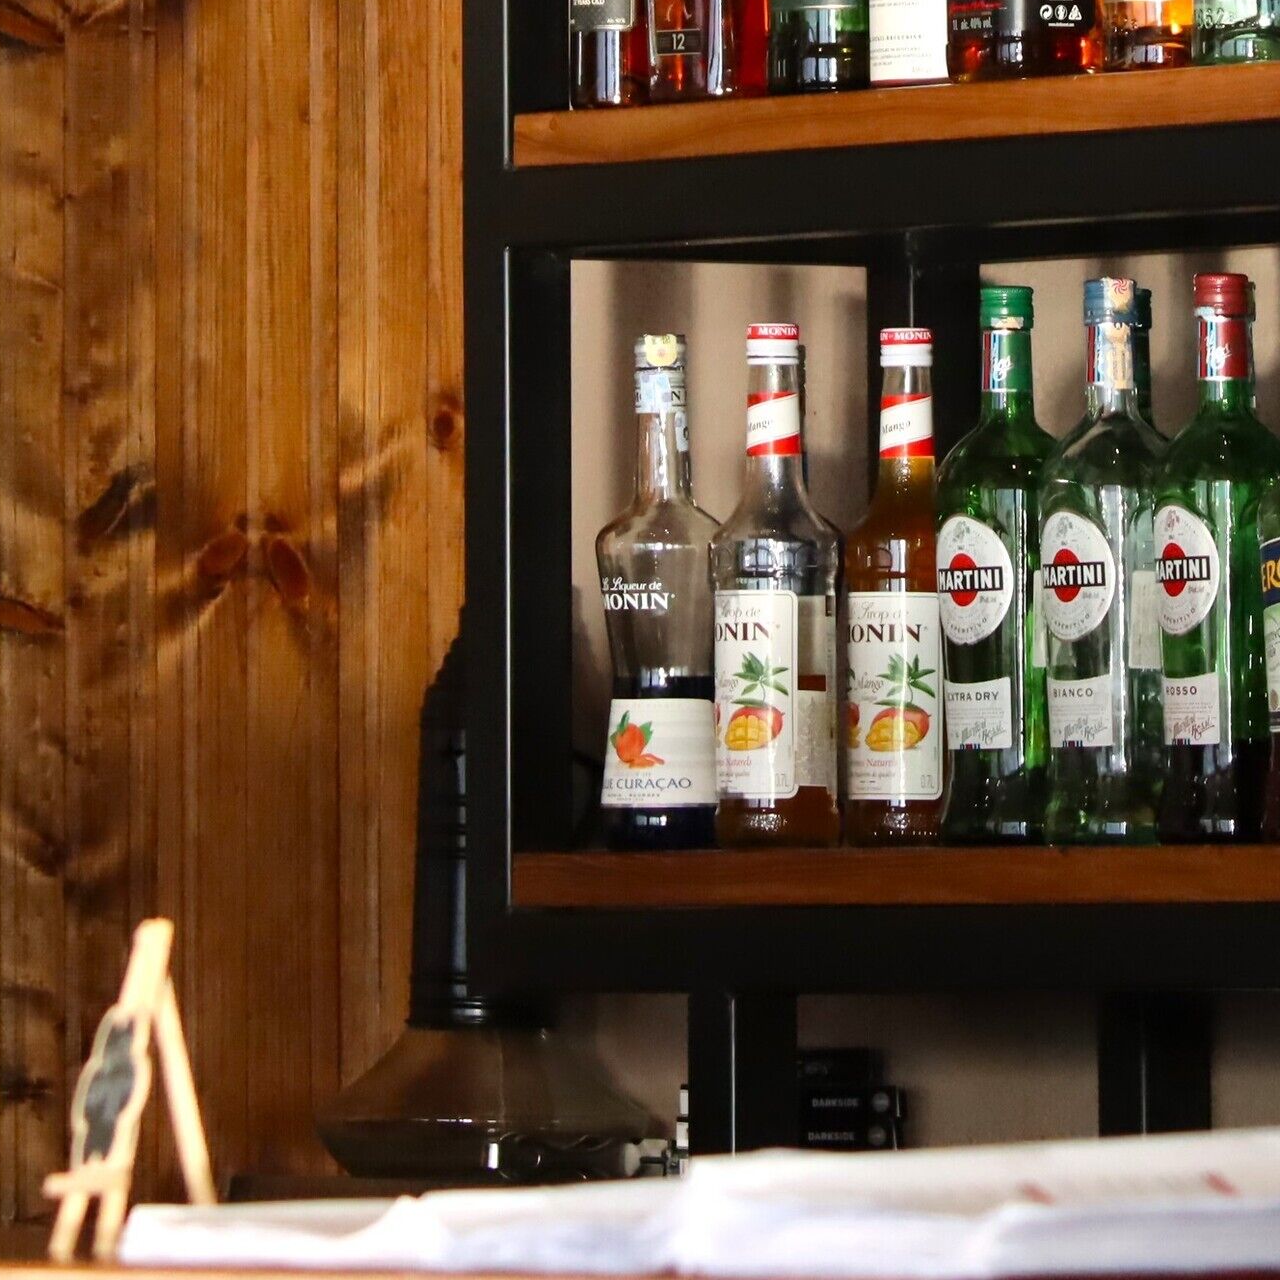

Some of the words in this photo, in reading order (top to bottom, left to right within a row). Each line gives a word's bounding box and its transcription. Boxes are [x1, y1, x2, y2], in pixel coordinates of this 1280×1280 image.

[672, 33, 686, 50] 12
[758, 325, 798, 336] MONIN
[894, 331, 932, 340] MONIN
[938, 568, 1002, 591] MARTINI
[1043, 564, 1104, 588] MARTINI
[610, 577, 647, 592] Liqueur
[648, 580, 662, 591] de
[975, 691, 1000, 701] DRY
[1052, 688, 1094, 699] BIANCO
[1165, 685, 1197, 696] ROSSO
[616, 777, 692, 791] CURAÇAO
[812, 1097, 859, 1108] DARKSIDE
